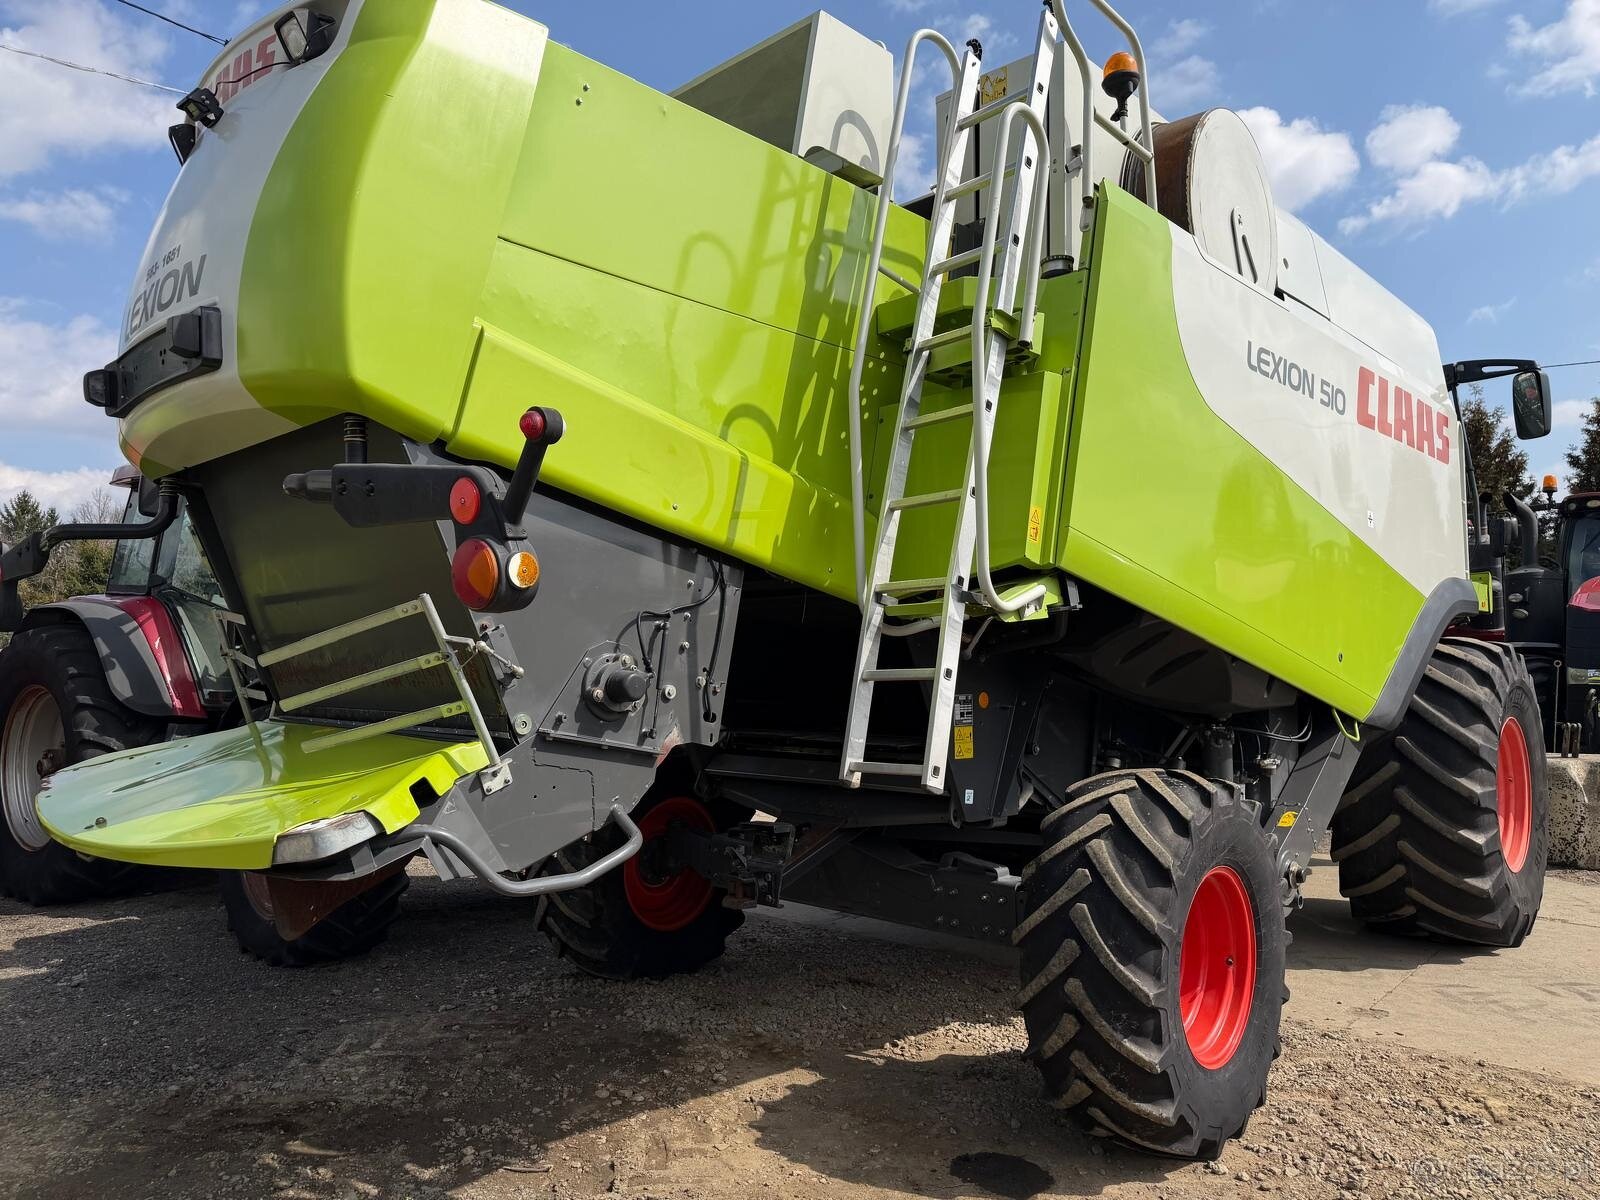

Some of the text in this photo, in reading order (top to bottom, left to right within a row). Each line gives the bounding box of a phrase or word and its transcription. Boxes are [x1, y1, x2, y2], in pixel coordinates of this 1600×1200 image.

[212, 33, 277, 106] AAS
[162, 244, 181, 268] 1651
[125, 253, 207, 342] LEXION
[1247, 340, 1347, 416] LEXION 510
[1356, 365, 1450, 465] CLAAS
